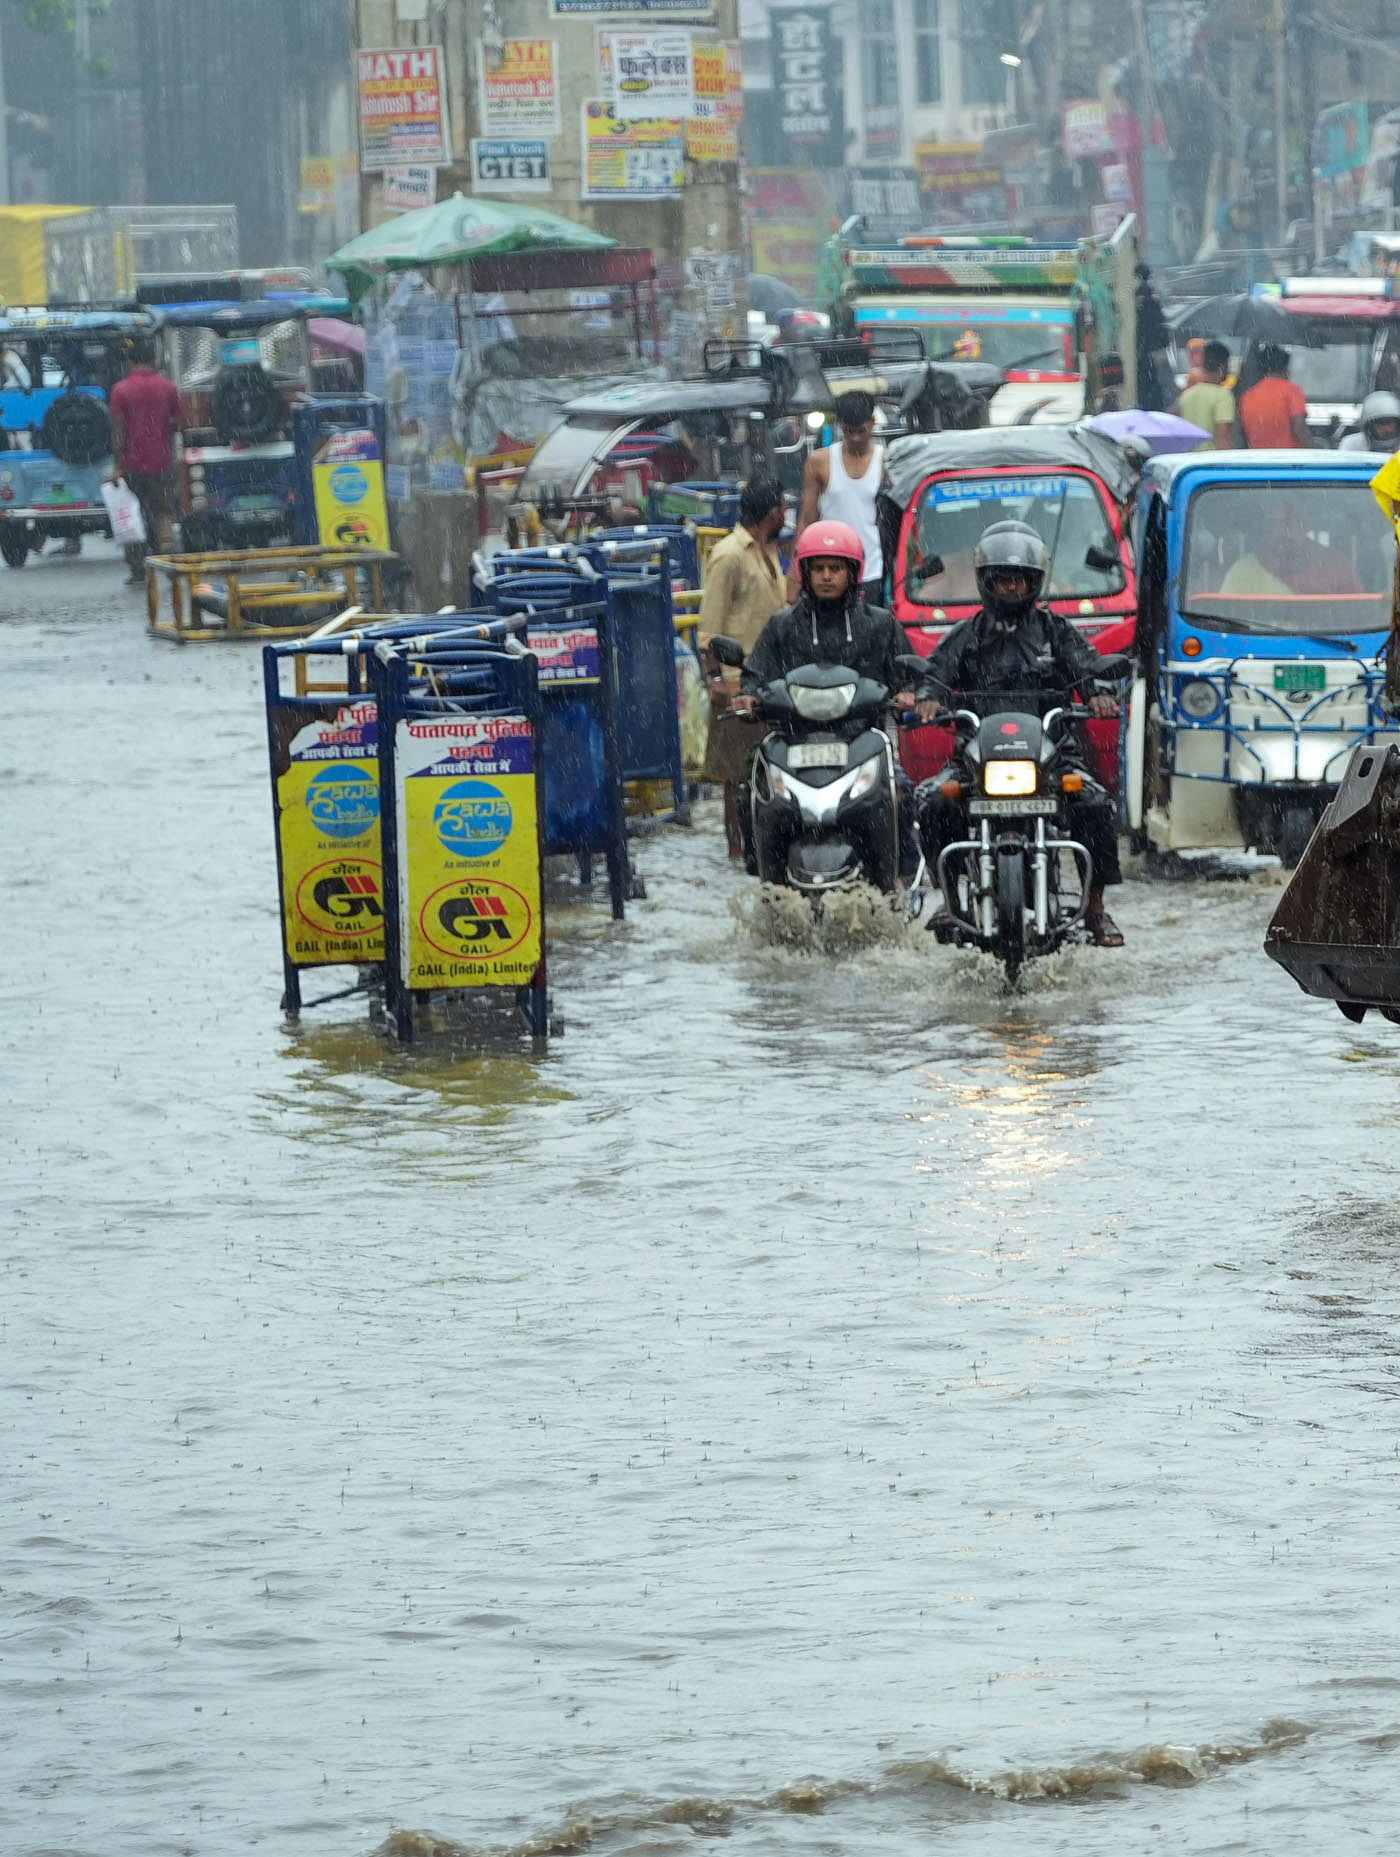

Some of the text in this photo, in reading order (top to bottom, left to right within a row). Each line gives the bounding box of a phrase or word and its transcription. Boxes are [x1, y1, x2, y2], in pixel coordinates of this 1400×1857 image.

[503, 40, 552, 60] ATH
[480, 156, 545, 179] CTET
[319, 729, 362, 745] पटना
[409, 719, 532, 743] यातायात पुलिस
[301, 745, 342, 760] आपकी
[343, 746, 365, 759] सेवा
[447, 744, 495, 760] पटना
[430, 758, 512, 775] आपकी सेवा में
[444, 859, 501, 869] An initiative of
[460, 883, 490, 895] गेल
[335, 921, 365, 931] GAIL
[295, 940, 321, 953] GAIL
[326, 940, 363, 954] (India)
[460, 944, 493, 954] GAIL
[417, 964, 446, 976] GAIL
[450, 962, 489, 977] (India)
